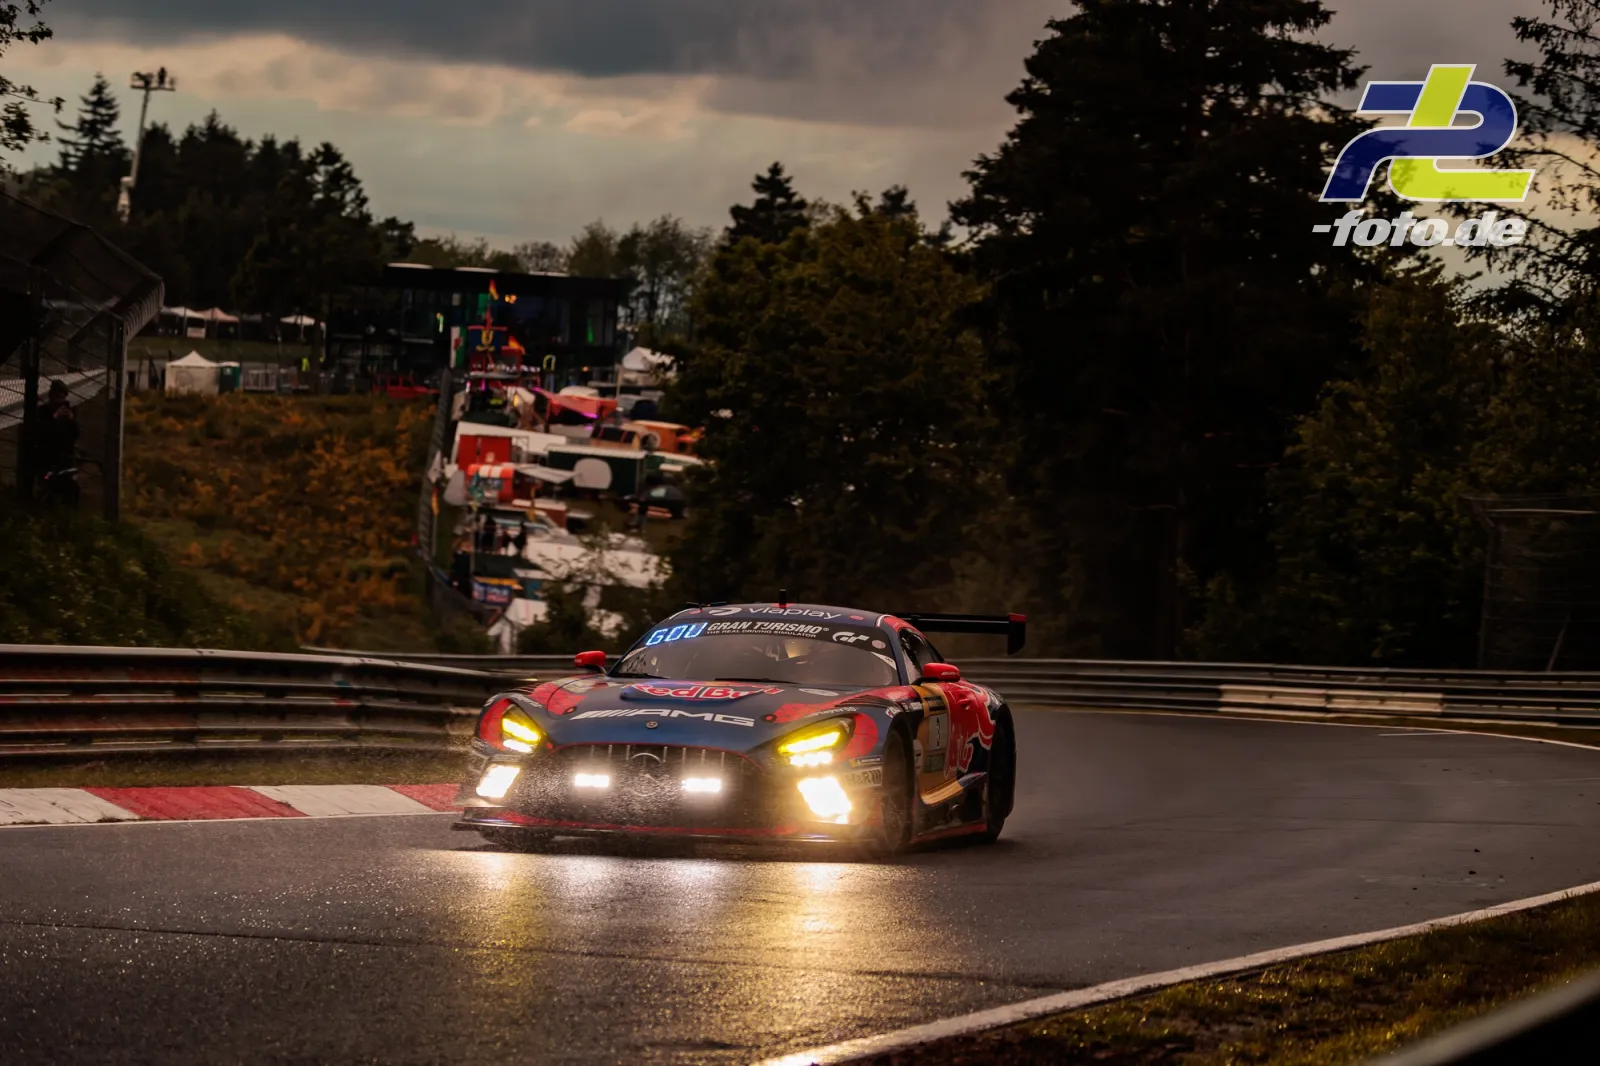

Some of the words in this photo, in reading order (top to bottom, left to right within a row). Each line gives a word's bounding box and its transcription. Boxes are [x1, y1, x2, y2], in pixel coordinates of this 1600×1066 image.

[749, 607, 842, 619] viaplay
[707, 621, 752, 631] GRAN
[645, 621, 709, 646] GOU
[773, 630, 817, 638] SIMULATOR
